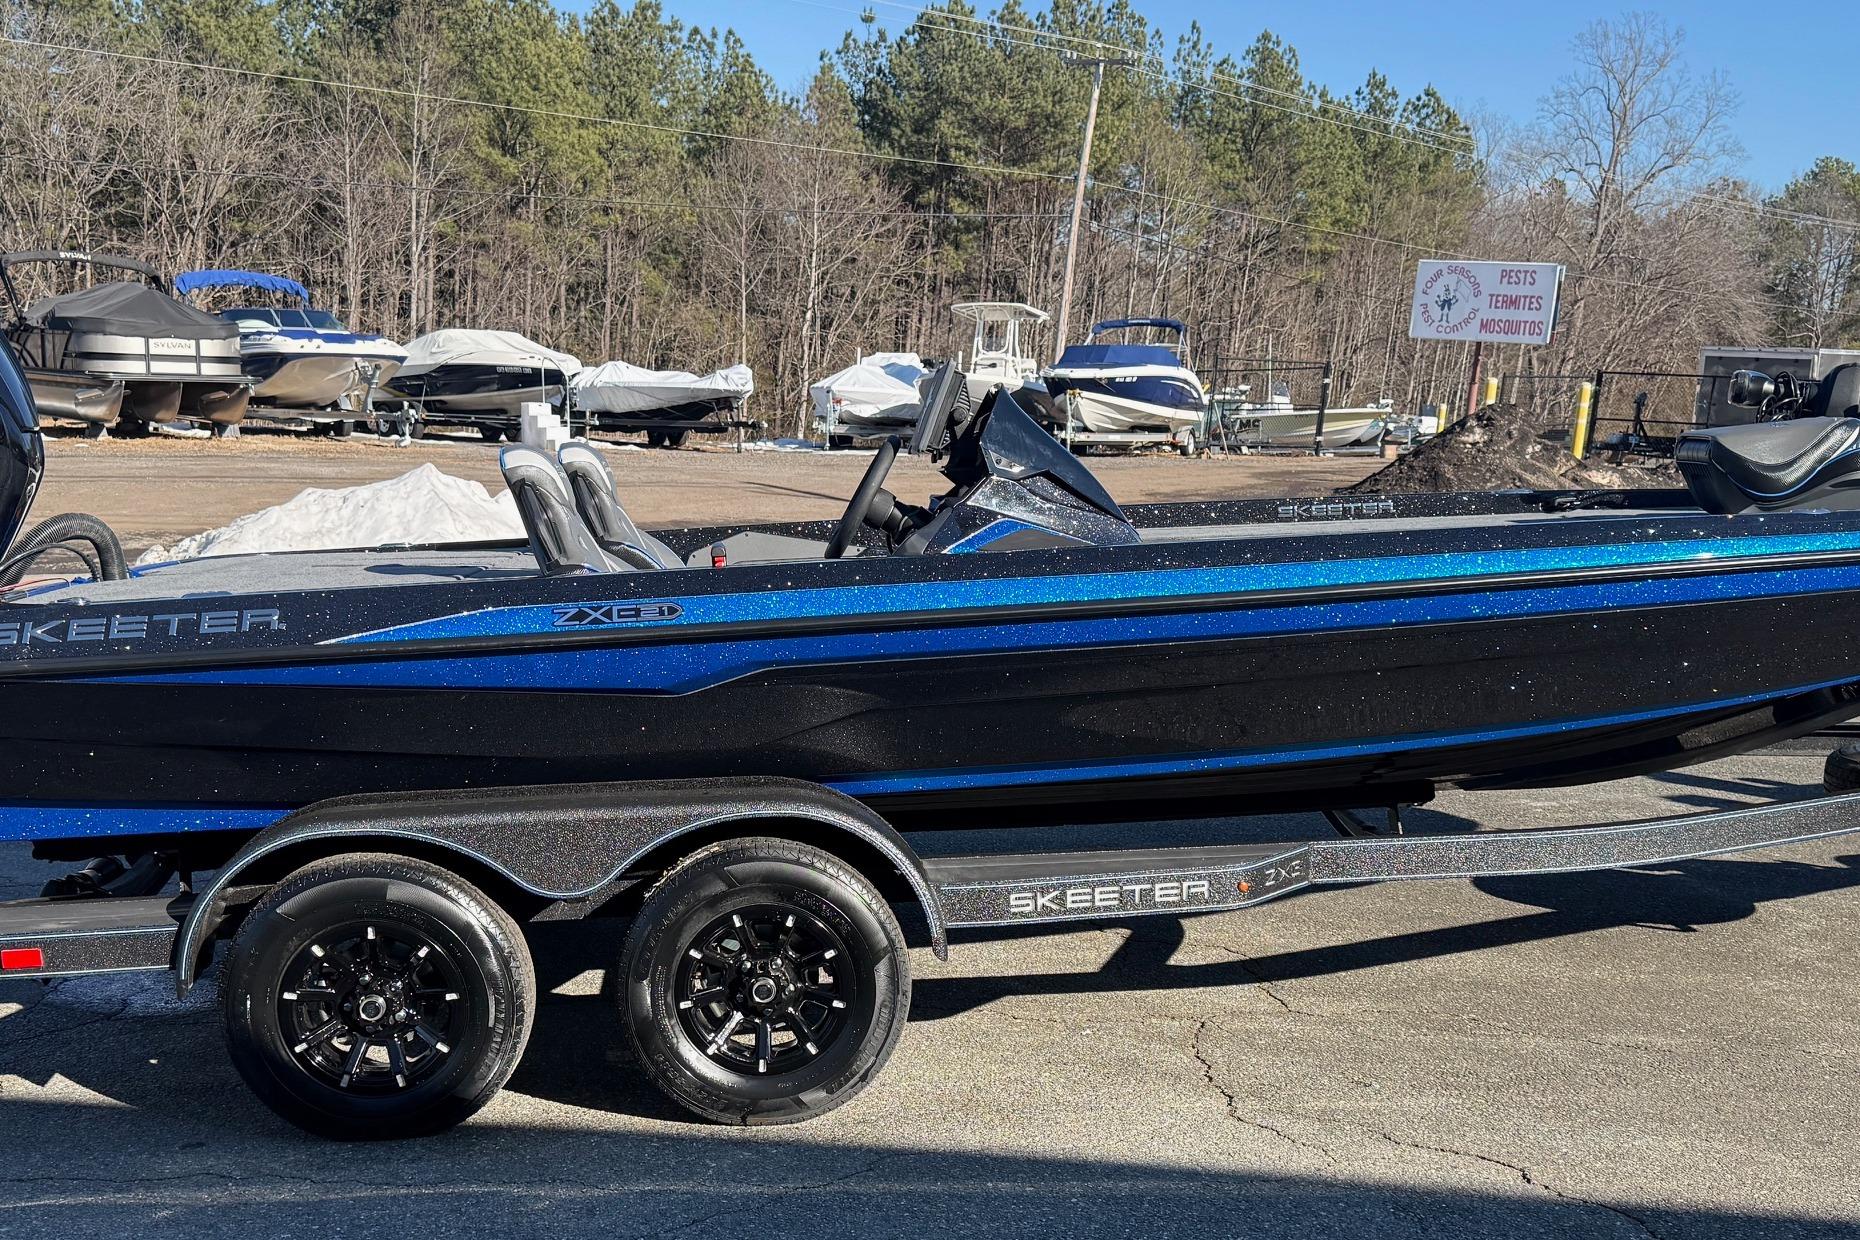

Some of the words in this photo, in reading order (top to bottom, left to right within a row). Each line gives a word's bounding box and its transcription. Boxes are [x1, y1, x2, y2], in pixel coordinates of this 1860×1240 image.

[1422, 268, 1444, 296] FOUR
[1447, 265, 1482, 298] SEASONS
[1499, 268, 1537, 286] PESTS
[1488, 293, 1543, 311] TERMITES
[1420, 303, 1435, 327] PEST
[1436, 307, 1480, 335] CONTROL
[1479, 318, 1544, 336] MOSQUITOS
[153, 341, 191, 349] SYLVAN
[1277, 500, 1396, 518] SKEETER
[1265, 860, 1301, 886] ZXE
[1009, 880, 1212, 913] SKEETER
